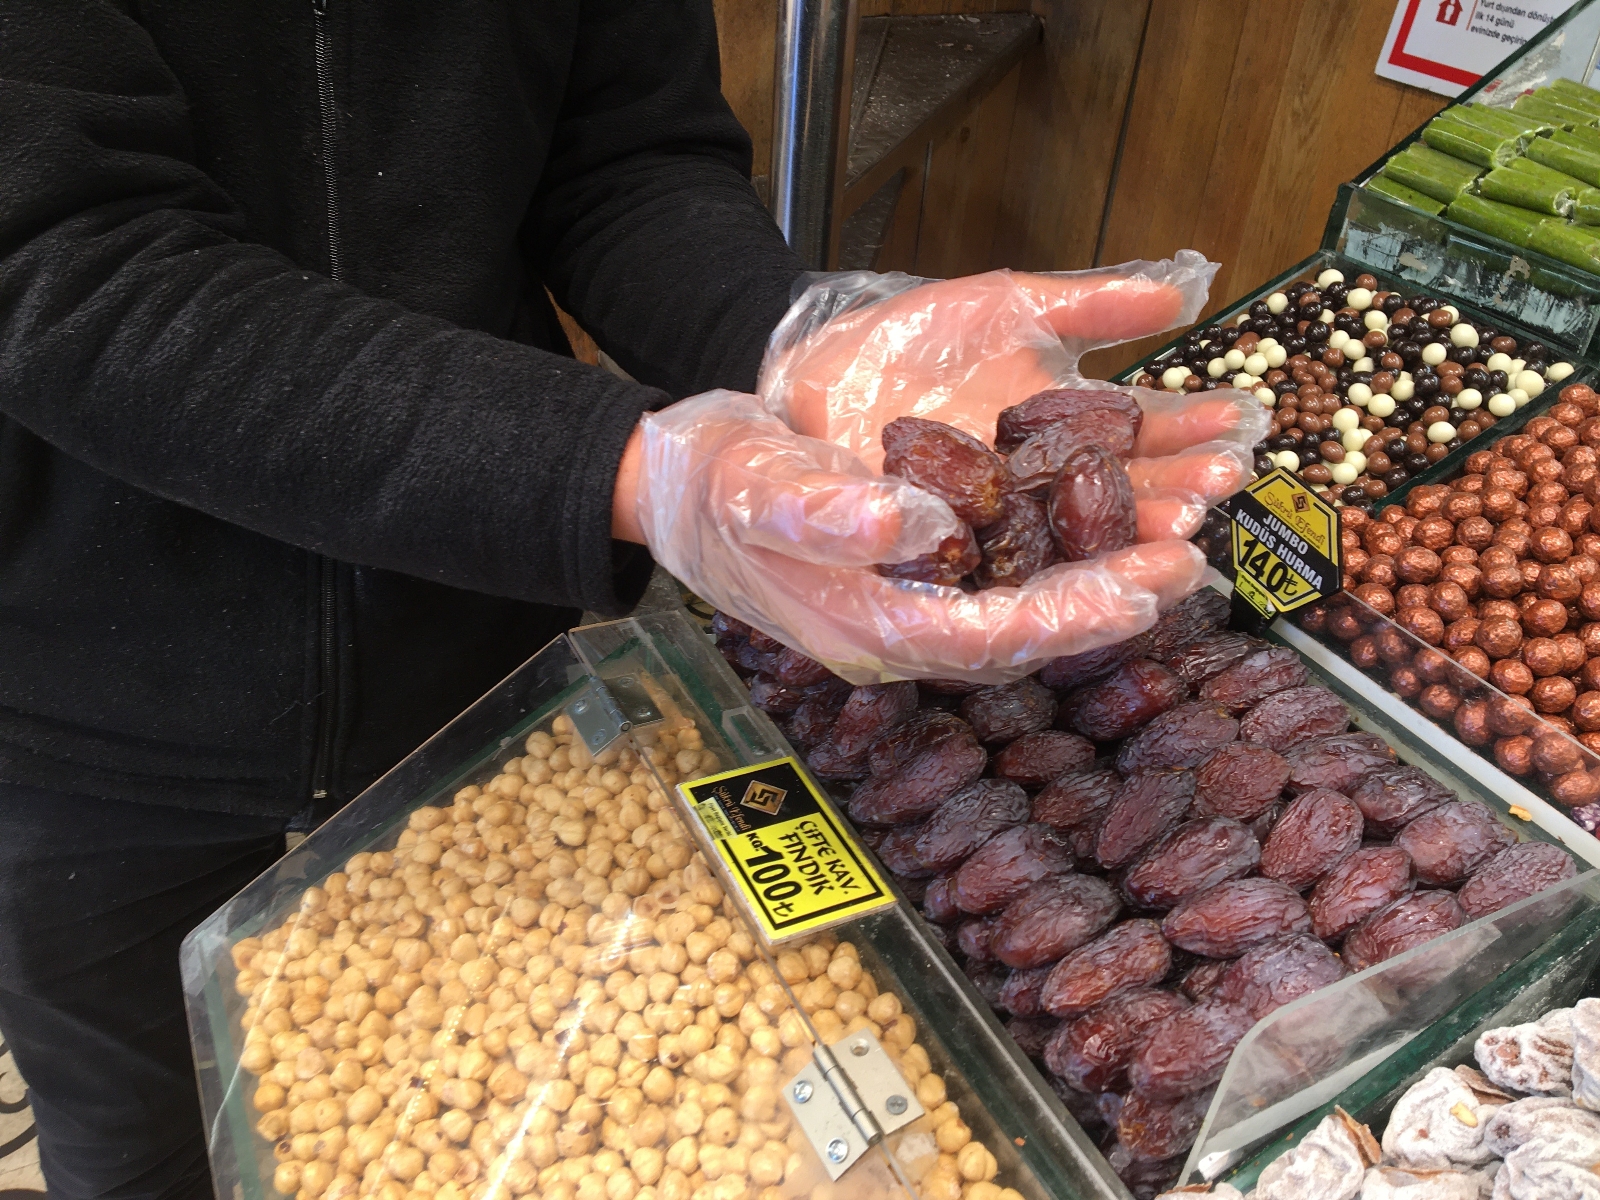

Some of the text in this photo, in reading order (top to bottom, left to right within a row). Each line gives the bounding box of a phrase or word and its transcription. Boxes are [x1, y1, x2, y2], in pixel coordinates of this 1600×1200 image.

[1480, 0, 1495, 9] Yurt
[1486, 12, 1494, 22] 14
[1495, 16, 1515, 29] günü
[1470, 25, 1500, 39] evinizde
[1262, 513, 1309, 555] JUMBO
[1264, 491, 1293, 519] Şükrü
[1295, 515, 1325, 546] Efendi
[1236, 508, 1277, 549] KUDÜS
[1276, 544, 1324, 590] HURMA
[777, 832, 835, 896] FINDIK
[825, 856, 861, 895] KAV.
